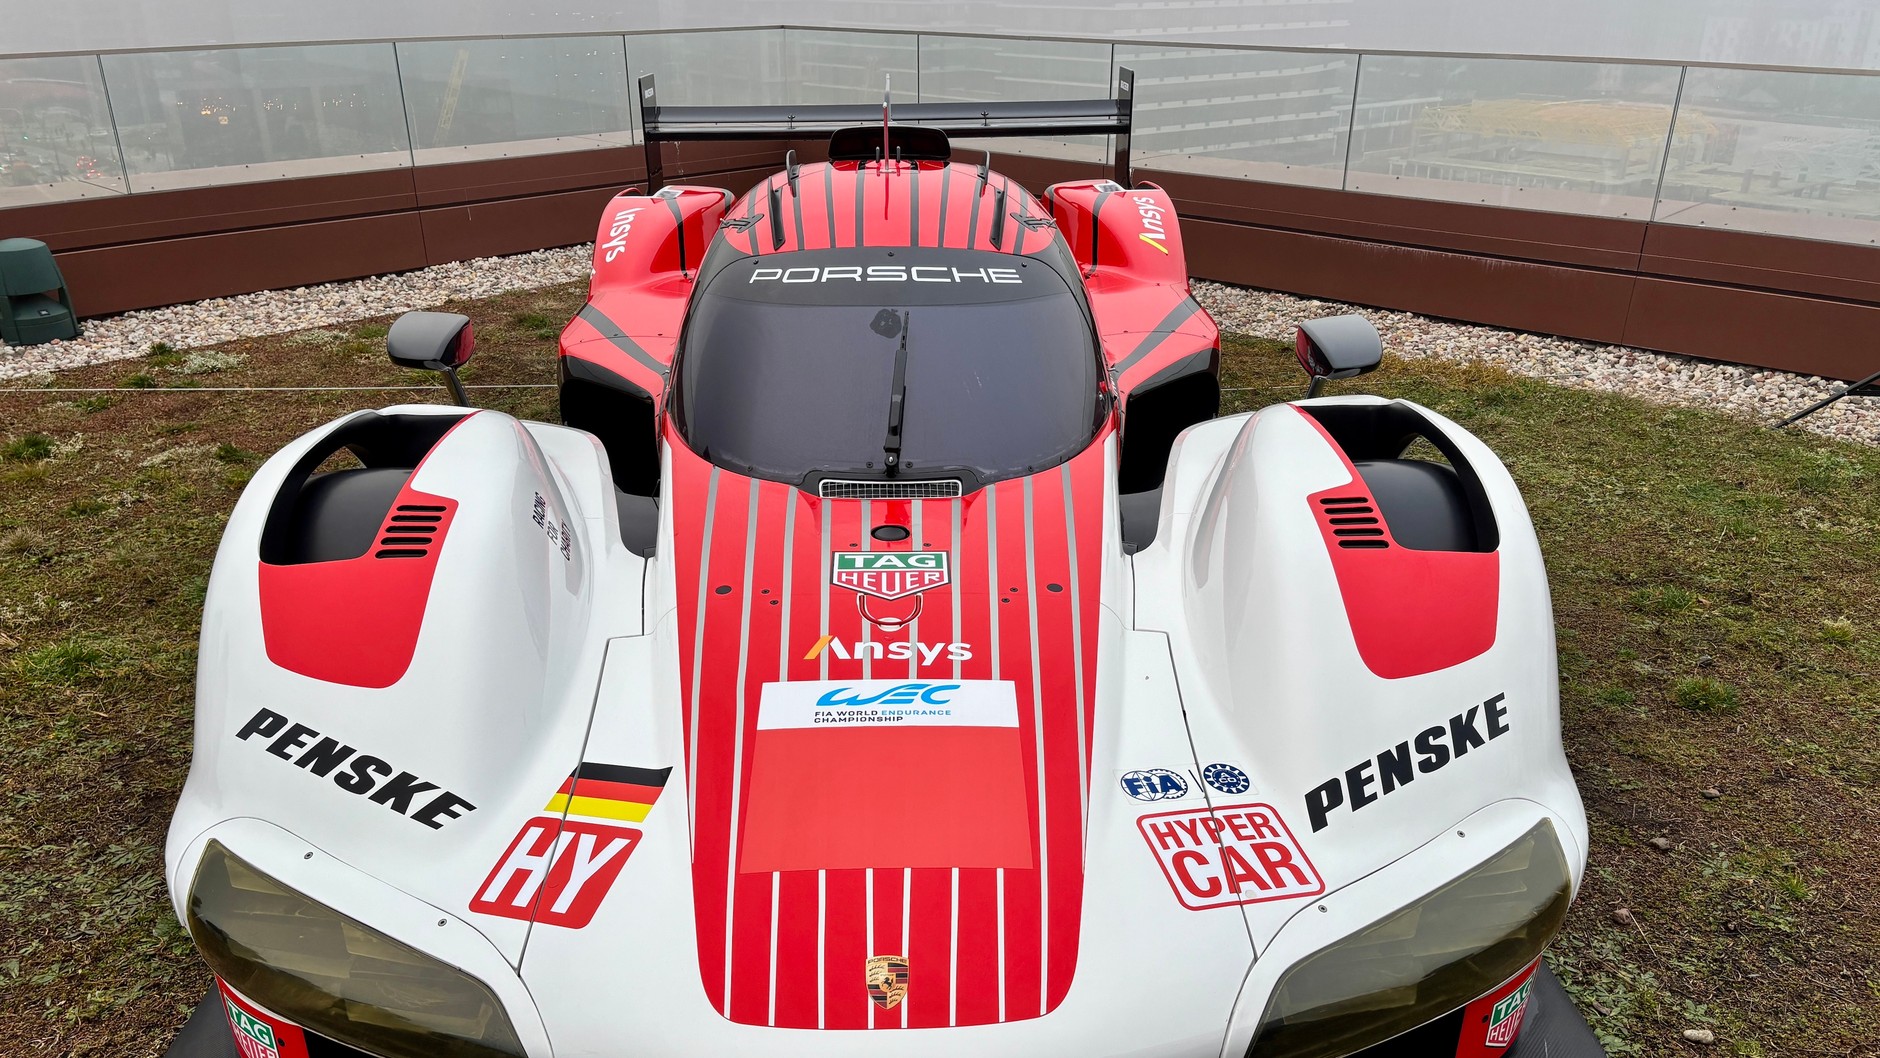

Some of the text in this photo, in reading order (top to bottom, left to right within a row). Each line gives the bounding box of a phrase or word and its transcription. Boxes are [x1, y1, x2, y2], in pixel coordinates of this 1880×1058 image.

[1132, 196, 1169, 255] Ansys
[749, 266, 1023, 284] PORSCHE
[532, 491, 546, 529] RACING
[547, 520, 559, 546] FOR
[844, 554, 936, 569] TAG
[841, 571, 941, 594] HEUER
[803, 635, 973, 666] Ansys
[816, 683, 961, 706] WEC
[814, 716, 903, 724] CHAMPIONSHIP
[235, 707, 477, 830] PENSKE
[1304, 692, 1510, 833] PENSKE
[1149, 812, 1277, 851] HYPER
[481, 826, 632, 914] HY
[1171, 840, 1312, 898] CAR
[867, 956, 907, 964] PORSCHE
[227, 1001, 270, 1045] TAG
